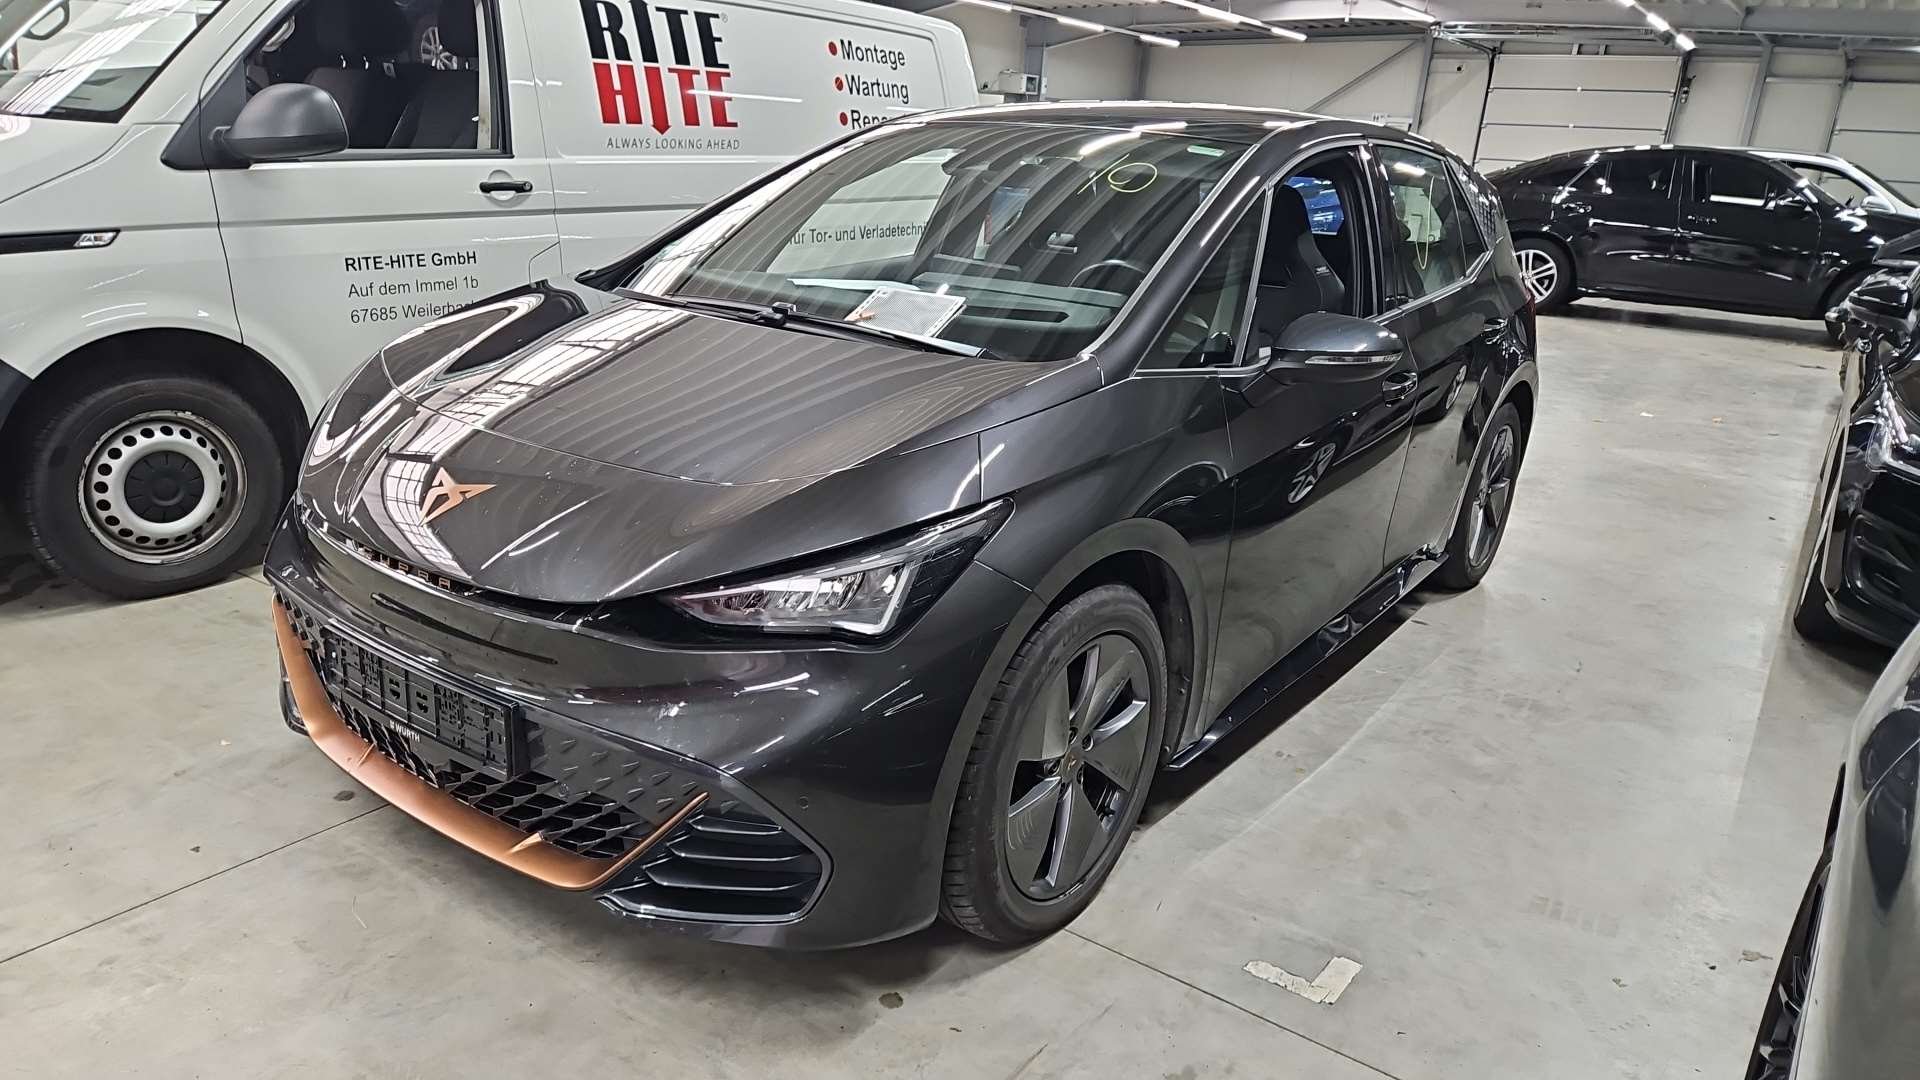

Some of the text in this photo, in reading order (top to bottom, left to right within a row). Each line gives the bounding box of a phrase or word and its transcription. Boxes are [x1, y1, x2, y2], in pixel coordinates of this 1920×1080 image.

[580, 0, 729, 69] RITE
[840, 38, 906, 70] Montage
[593, 62, 738, 135] HITE
[845, 73, 909, 104] Wartung
[850, 109, 888, 130] Rep
[607, 138, 740, 150] ALWAYS LOOKING AHEAD
[809, 228, 832, 243] Tor-
[835, 226, 856, 242] und
[344, 251, 477, 272] RITE-HITE GmbH
[348, 275, 479, 298] Auf dem Immel 1b
[350, 300, 475, 323] 67685 Weilerba
